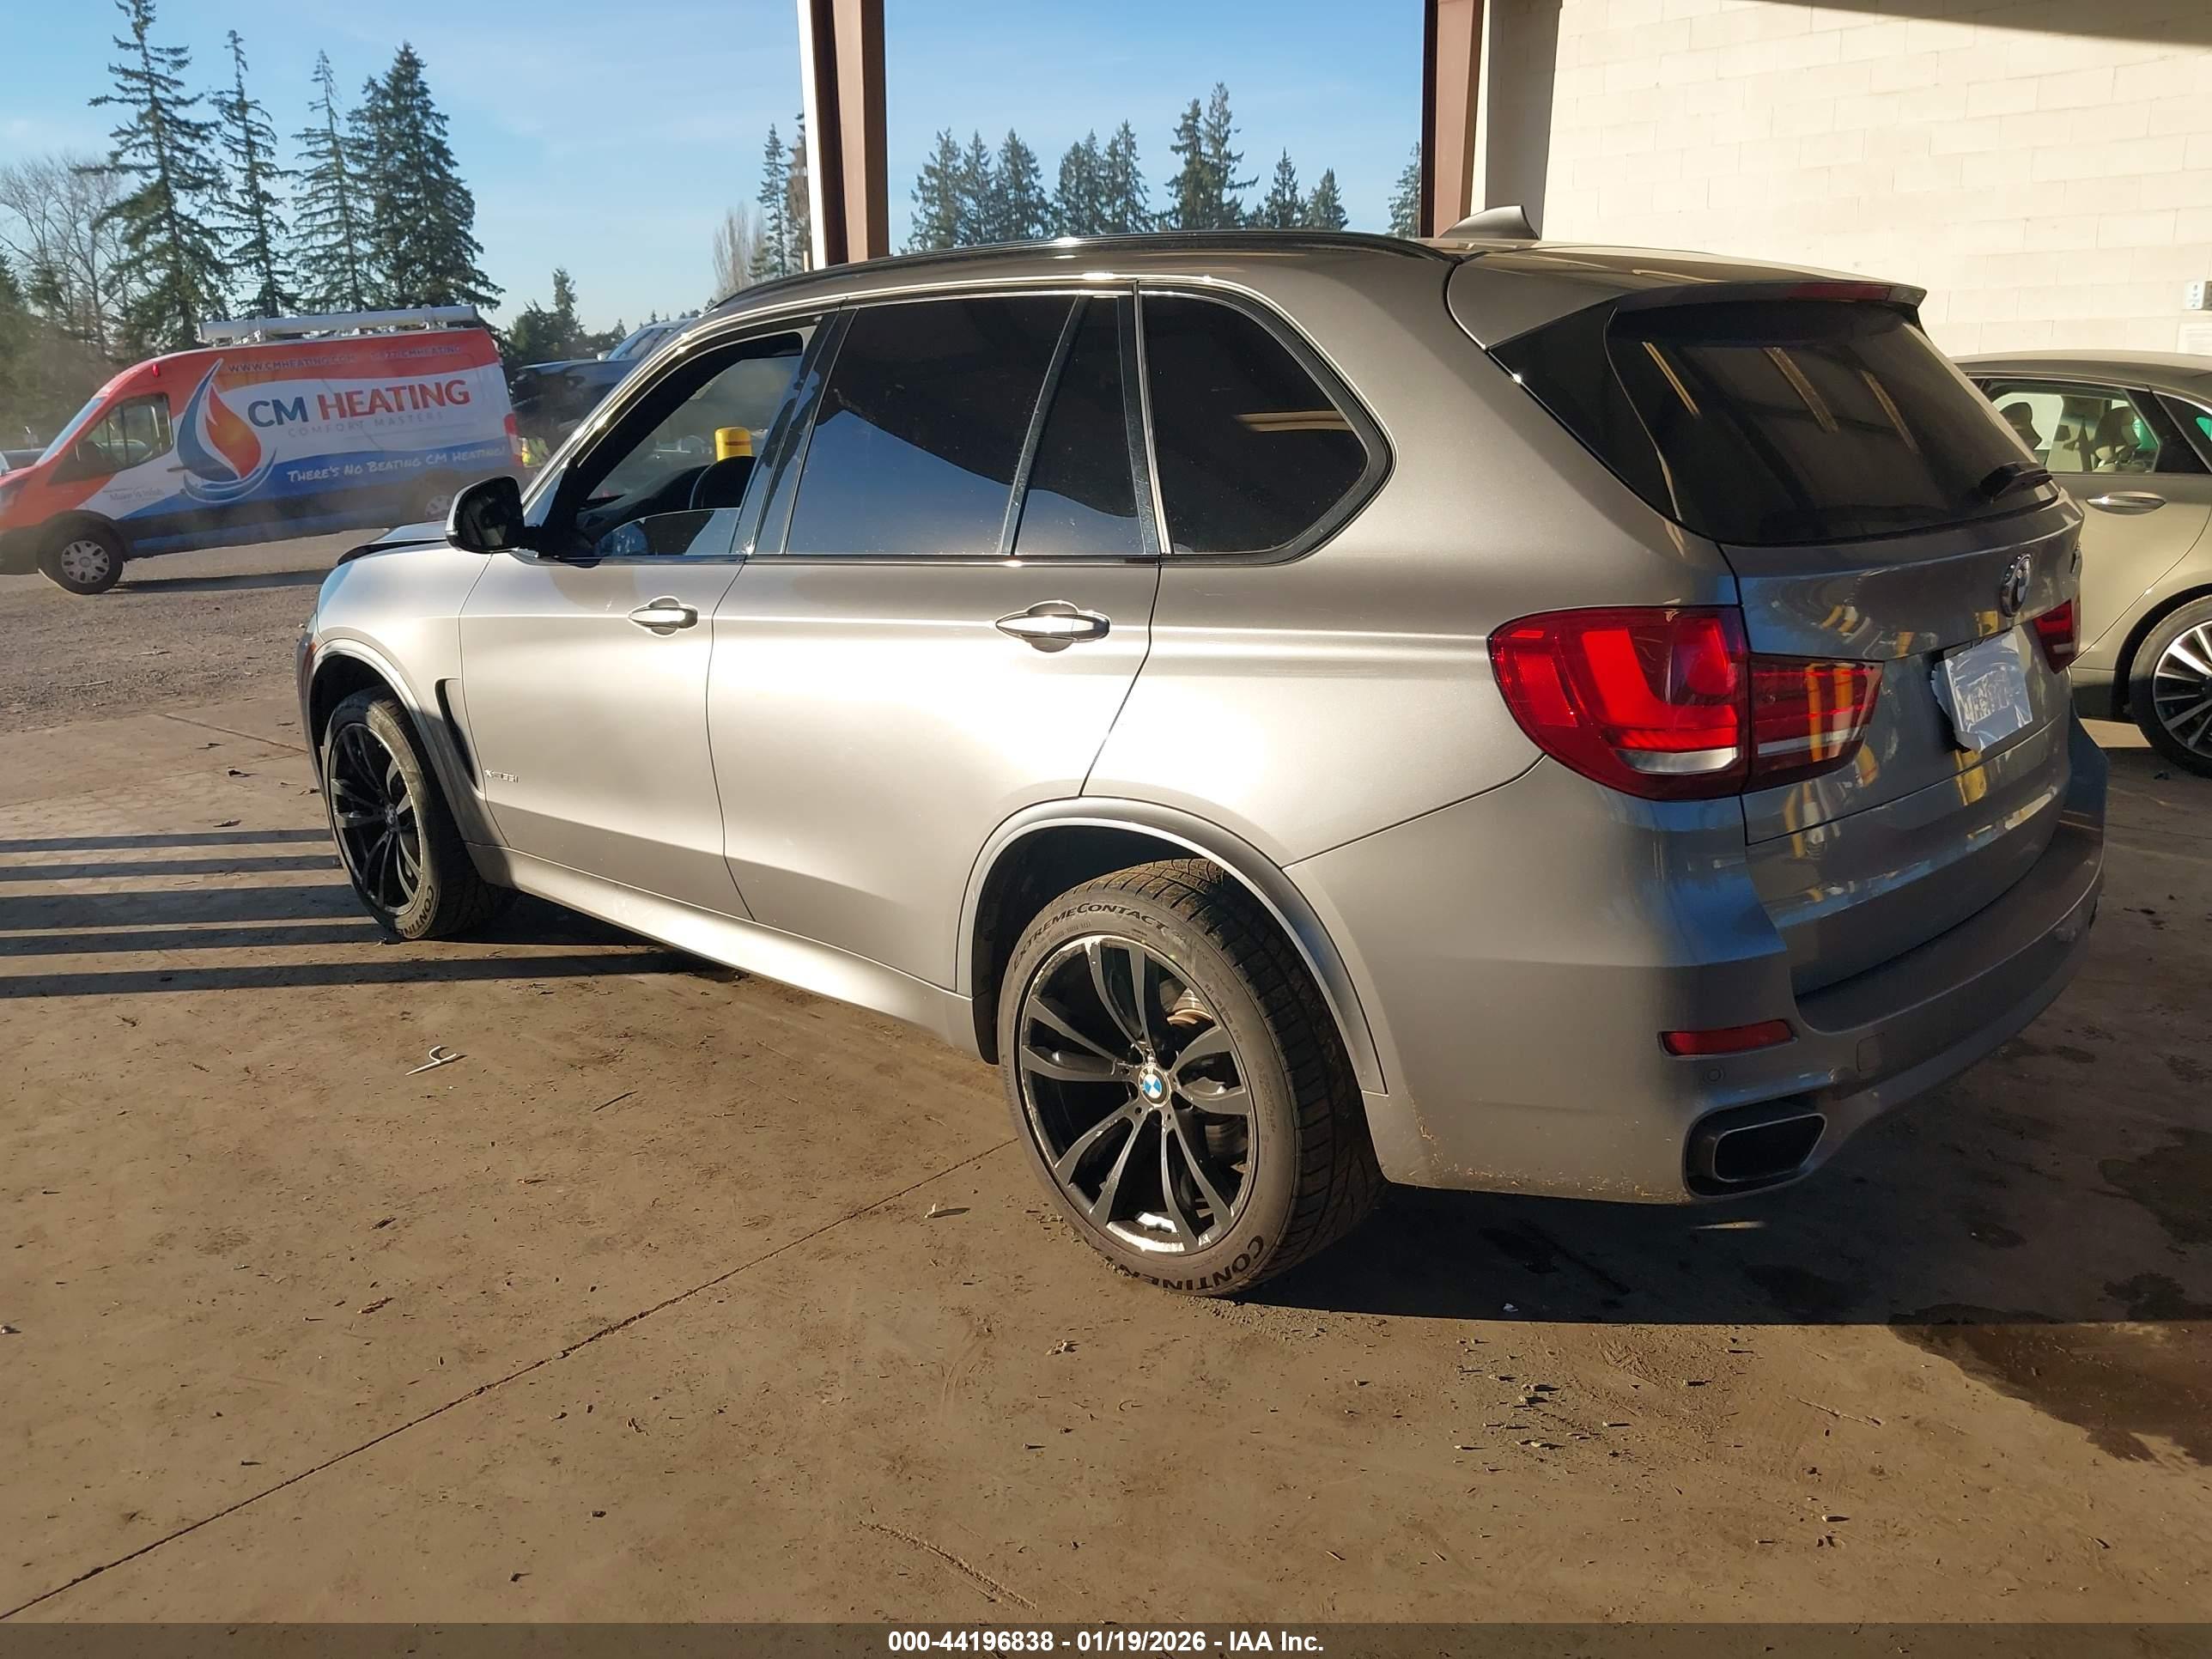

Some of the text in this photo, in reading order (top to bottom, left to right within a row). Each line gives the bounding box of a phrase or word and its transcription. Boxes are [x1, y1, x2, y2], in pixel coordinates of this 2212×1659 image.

[247, 379, 471, 428] CM HEATING
[288, 411, 444, 438] COMFORT MASTERS
[287, 447, 506, 483] THERE'S NO BEATING CM HEATING!
